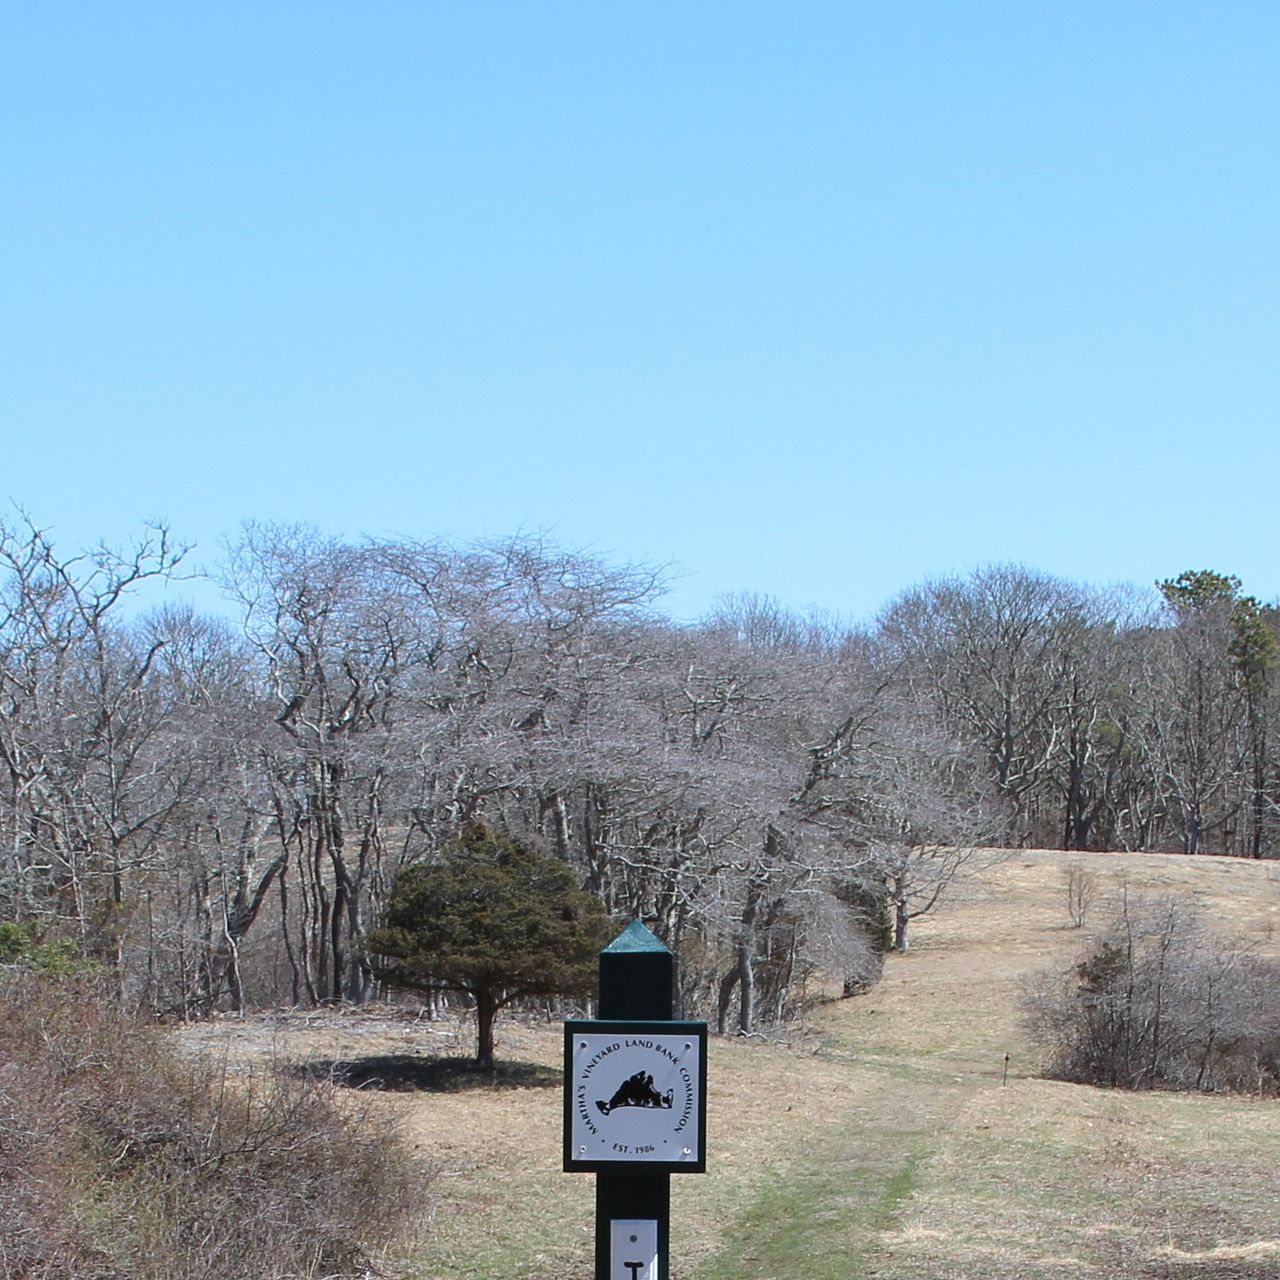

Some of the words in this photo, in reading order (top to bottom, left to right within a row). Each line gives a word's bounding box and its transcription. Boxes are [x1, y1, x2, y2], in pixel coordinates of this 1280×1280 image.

[625, 1040, 653, 1048] LAND
[655, 1044, 680, 1065] BANK
[582, 1042, 620, 1080] VINEYARD
[578, 1084, 598, 1135] MARTHA'S
[674, 1068, 693, 1134] COMMISSION
[612, 1143, 632, 1154] EST.
[636, 1144, 655, 1154] 1986
